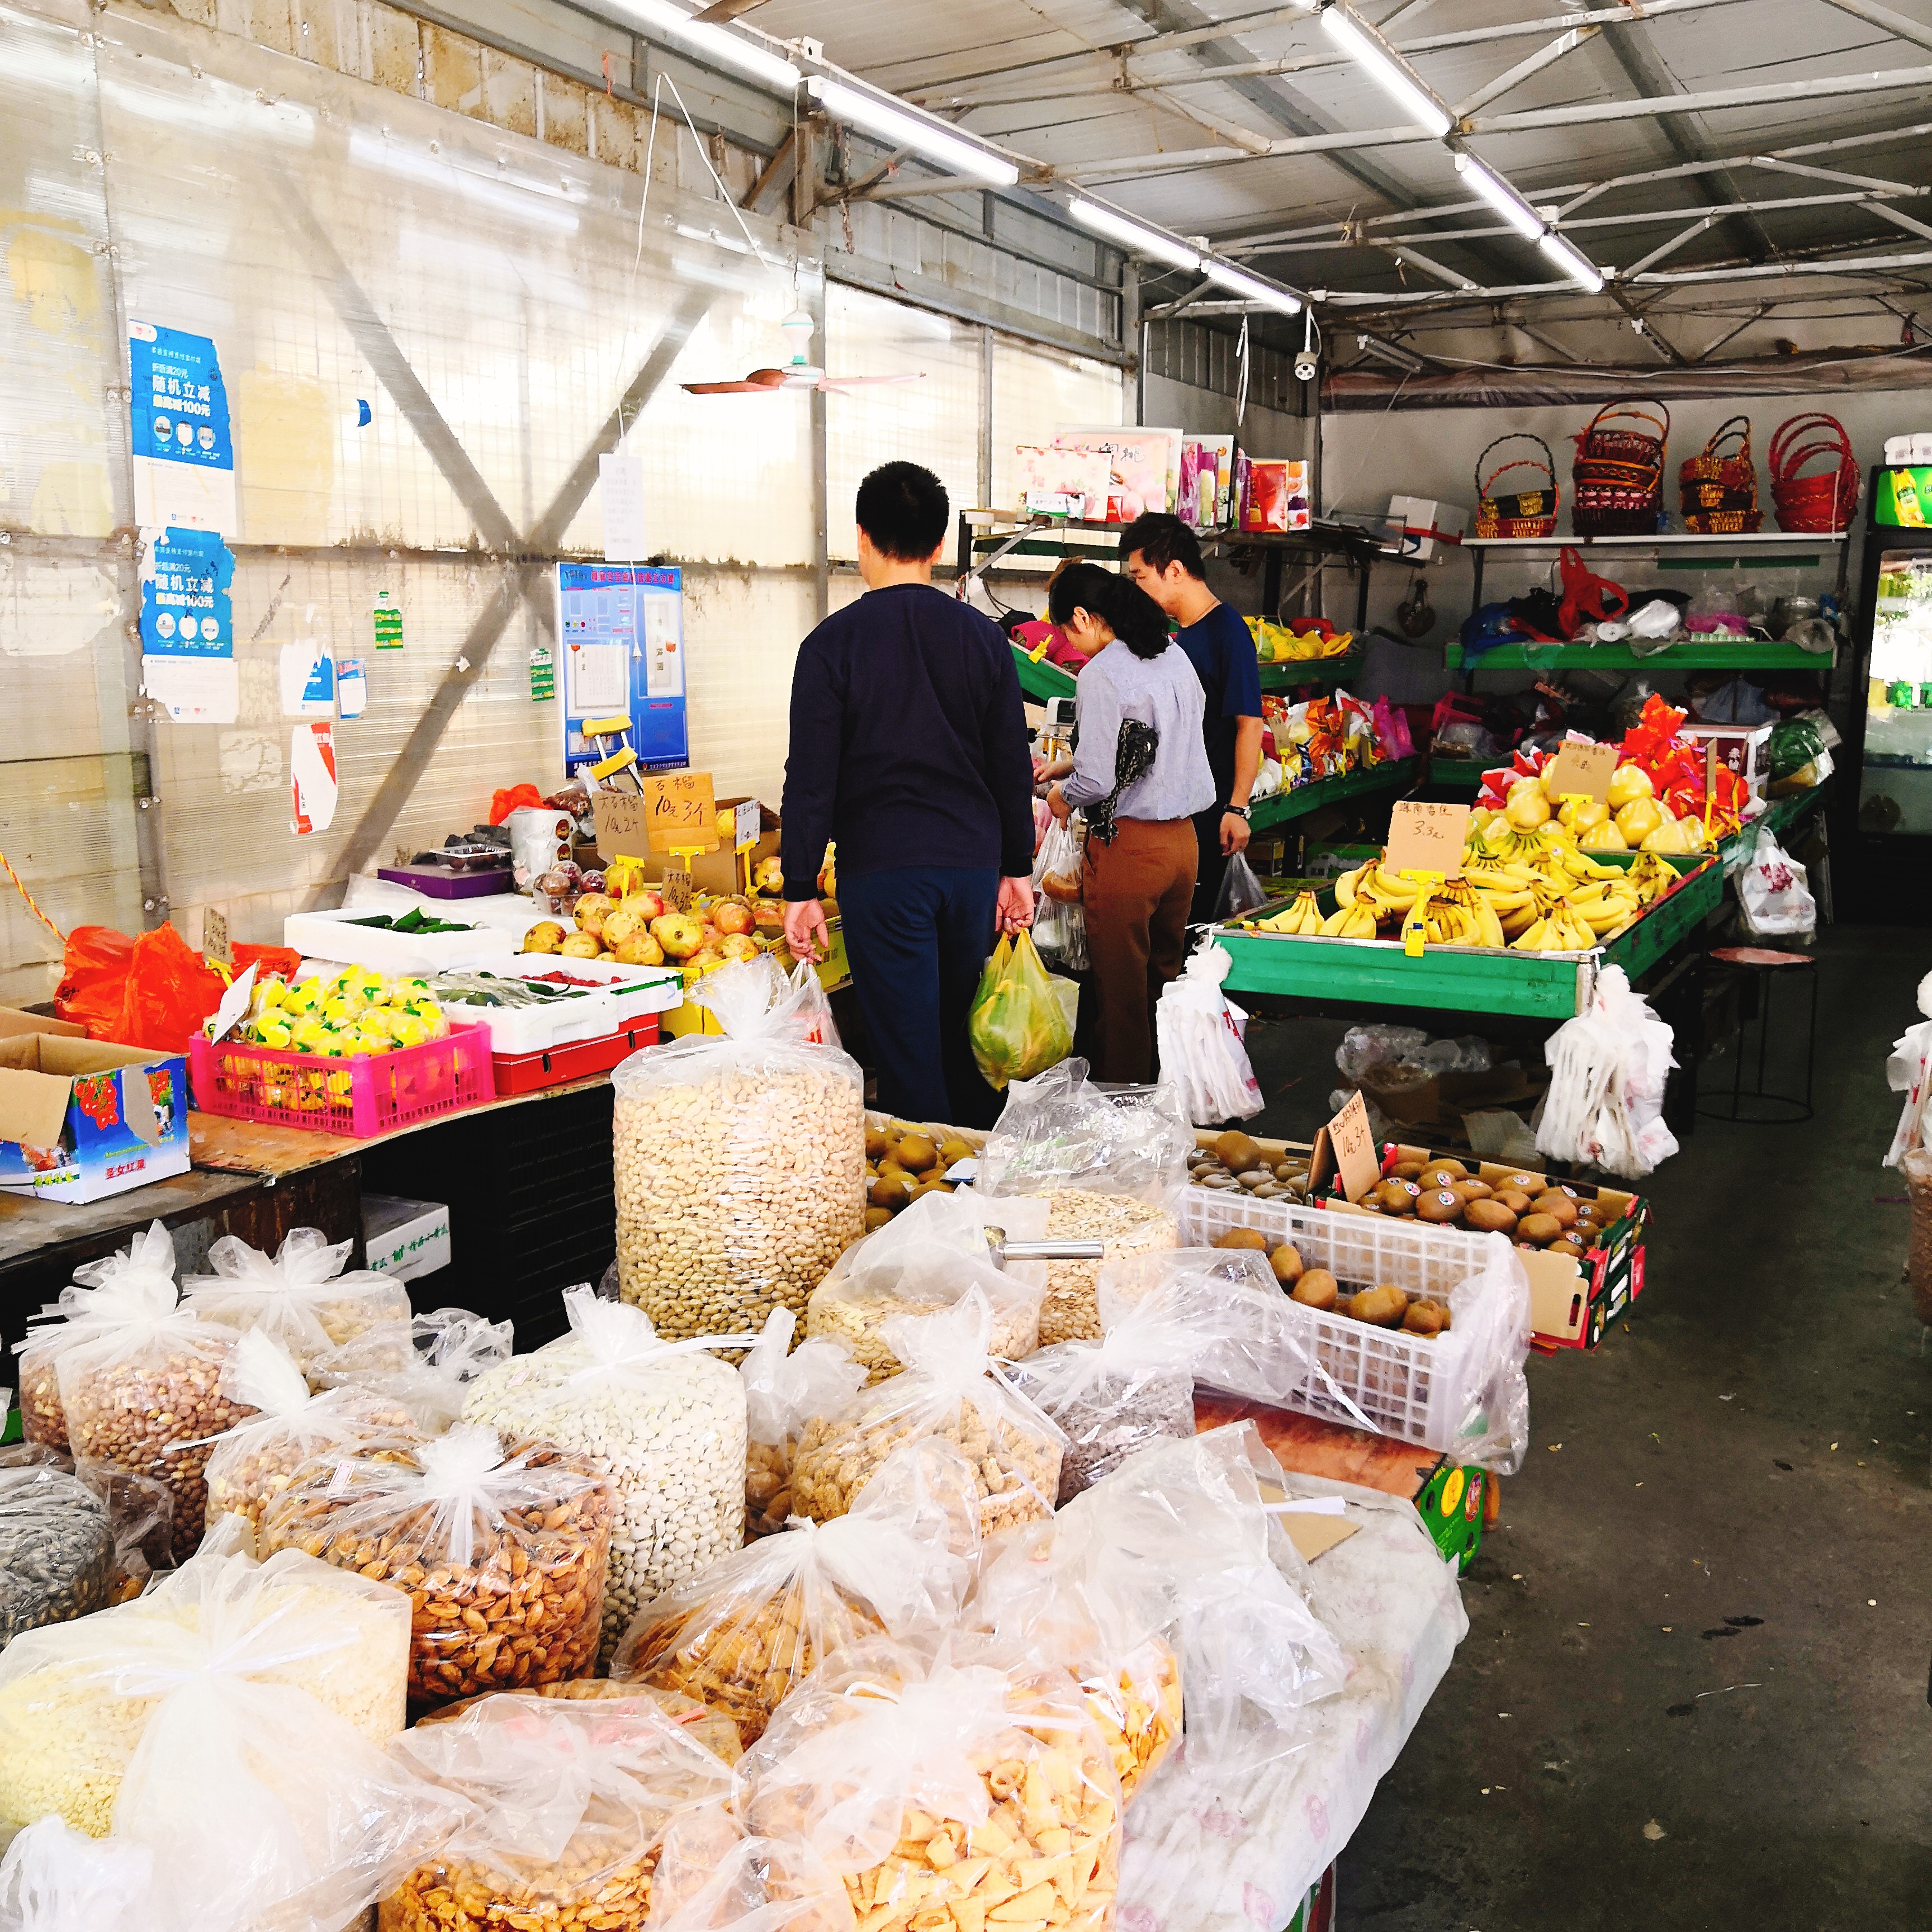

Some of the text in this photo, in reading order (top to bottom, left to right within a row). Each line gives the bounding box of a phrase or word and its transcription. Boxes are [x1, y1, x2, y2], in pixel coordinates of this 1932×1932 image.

[153, 375, 211, 402] 随机立减
[155, 573, 214, 594] 随机立减
